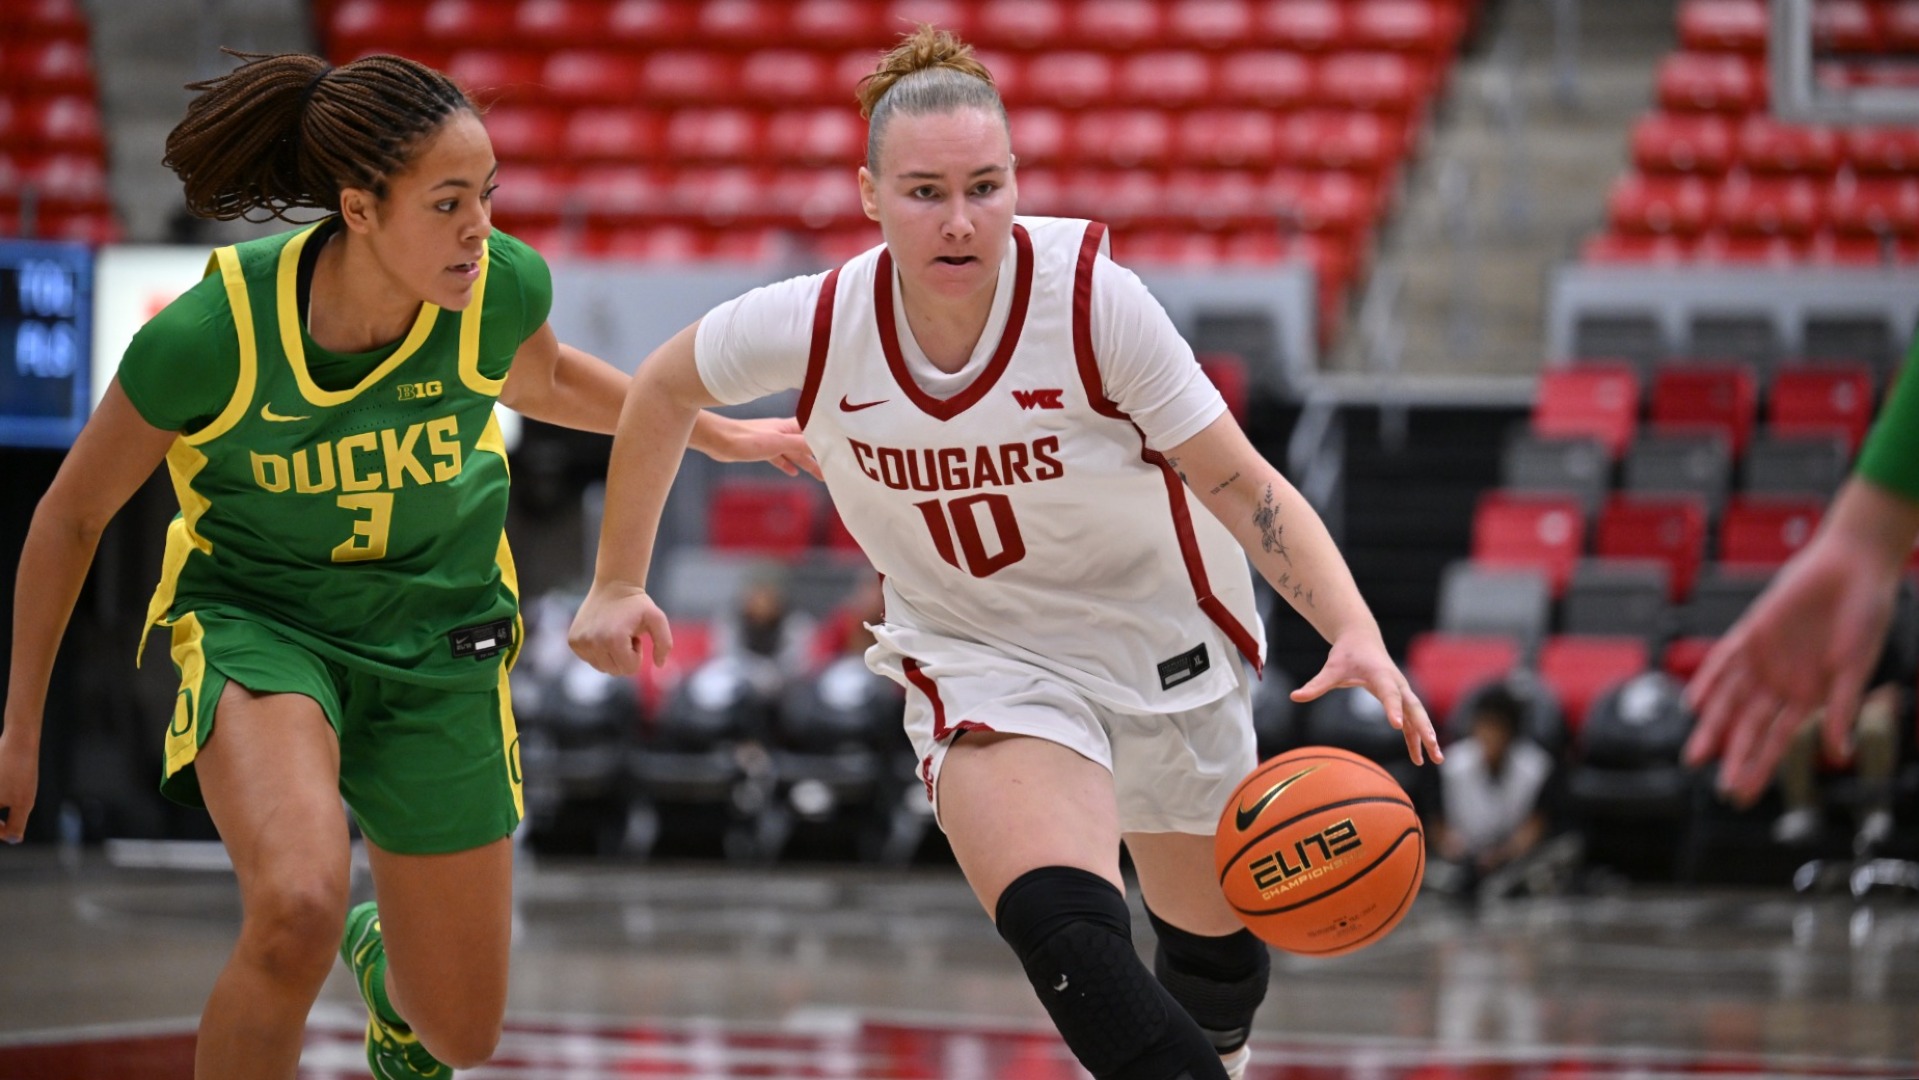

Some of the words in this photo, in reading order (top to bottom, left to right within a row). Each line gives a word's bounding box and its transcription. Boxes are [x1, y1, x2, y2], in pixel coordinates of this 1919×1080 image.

[250, 415, 462, 493] DUCKS
[847, 435, 1064, 491] COUGARS
[331, 492, 394, 562] 3
[912, 493, 1026, 578] 10
[1249, 818, 1362, 891] ELITE
[1262, 853, 1363, 900] CHAMPIONS
